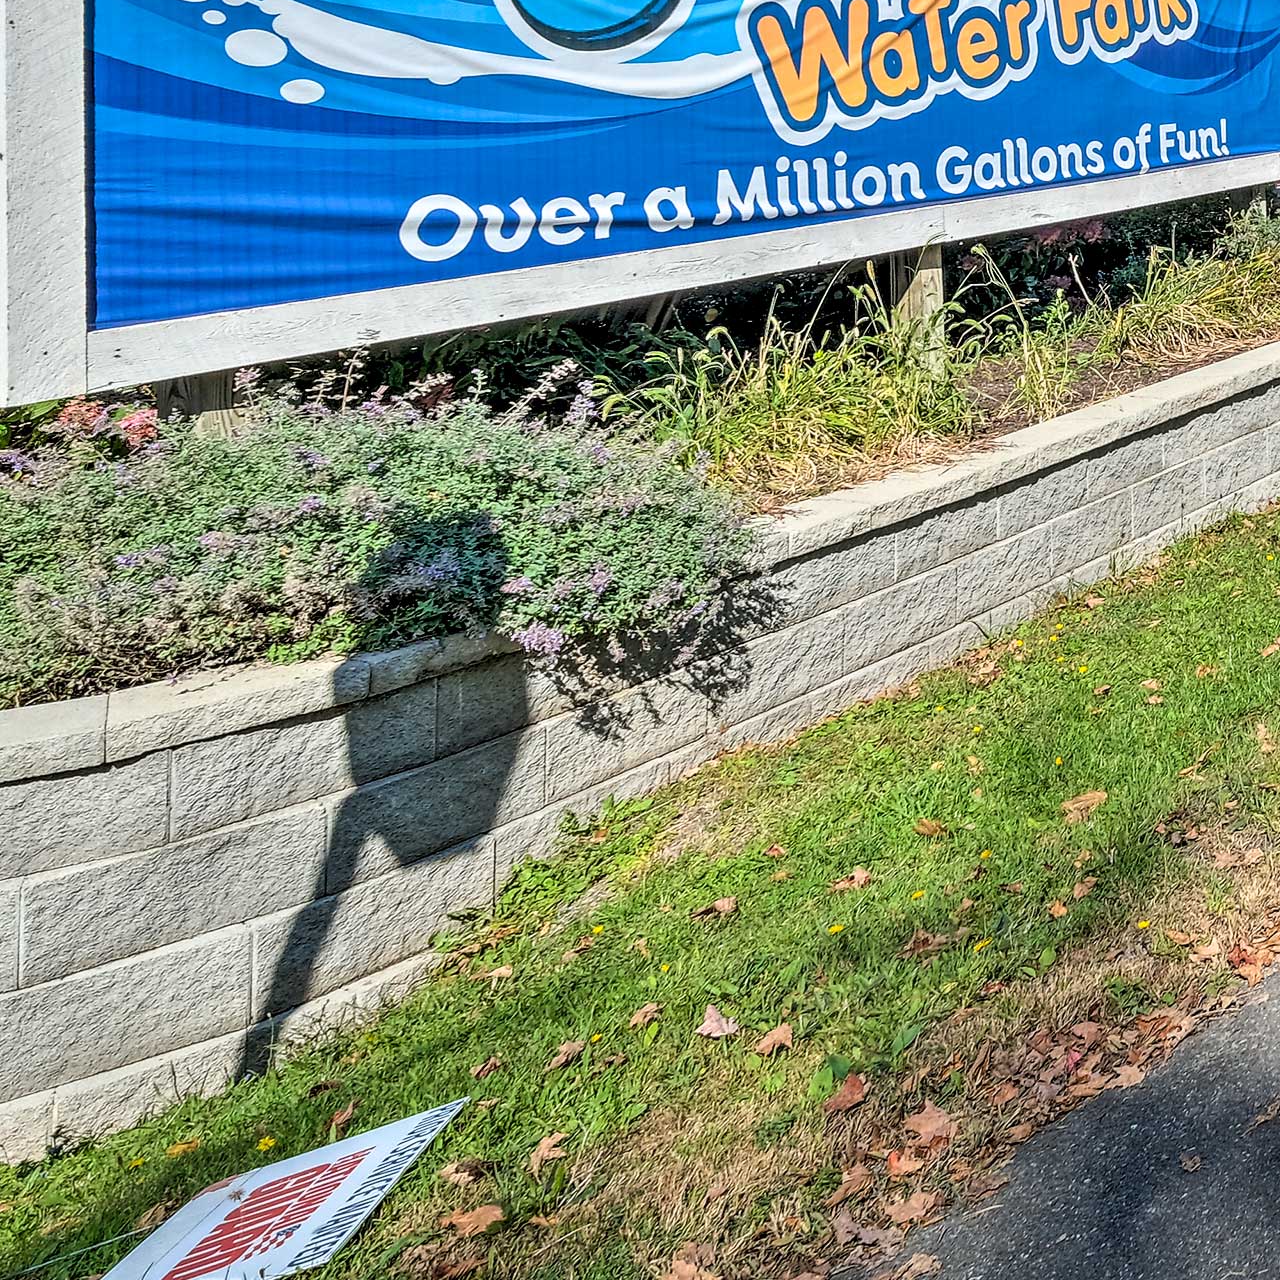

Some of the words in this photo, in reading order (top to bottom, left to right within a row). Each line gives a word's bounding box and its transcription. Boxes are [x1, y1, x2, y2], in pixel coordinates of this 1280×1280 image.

[400, 191, 624, 262] Over
[643, 183, 695, 231] a
[712, 151, 926, 225] Million
[935, 138, 1103, 193] Gallons
[1112, 122, 1150, 175] of
[1159, 117, 1229, 162] Fun!
[398, 1099, 464, 1146] PRIOR
[267, 1145, 377, 1234] NATIONAL
[345, 1138, 427, 1202] SERVICE
[161, 1163, 332, 1280] GUARD
[287, 1194, 381, 1267] WANTED
